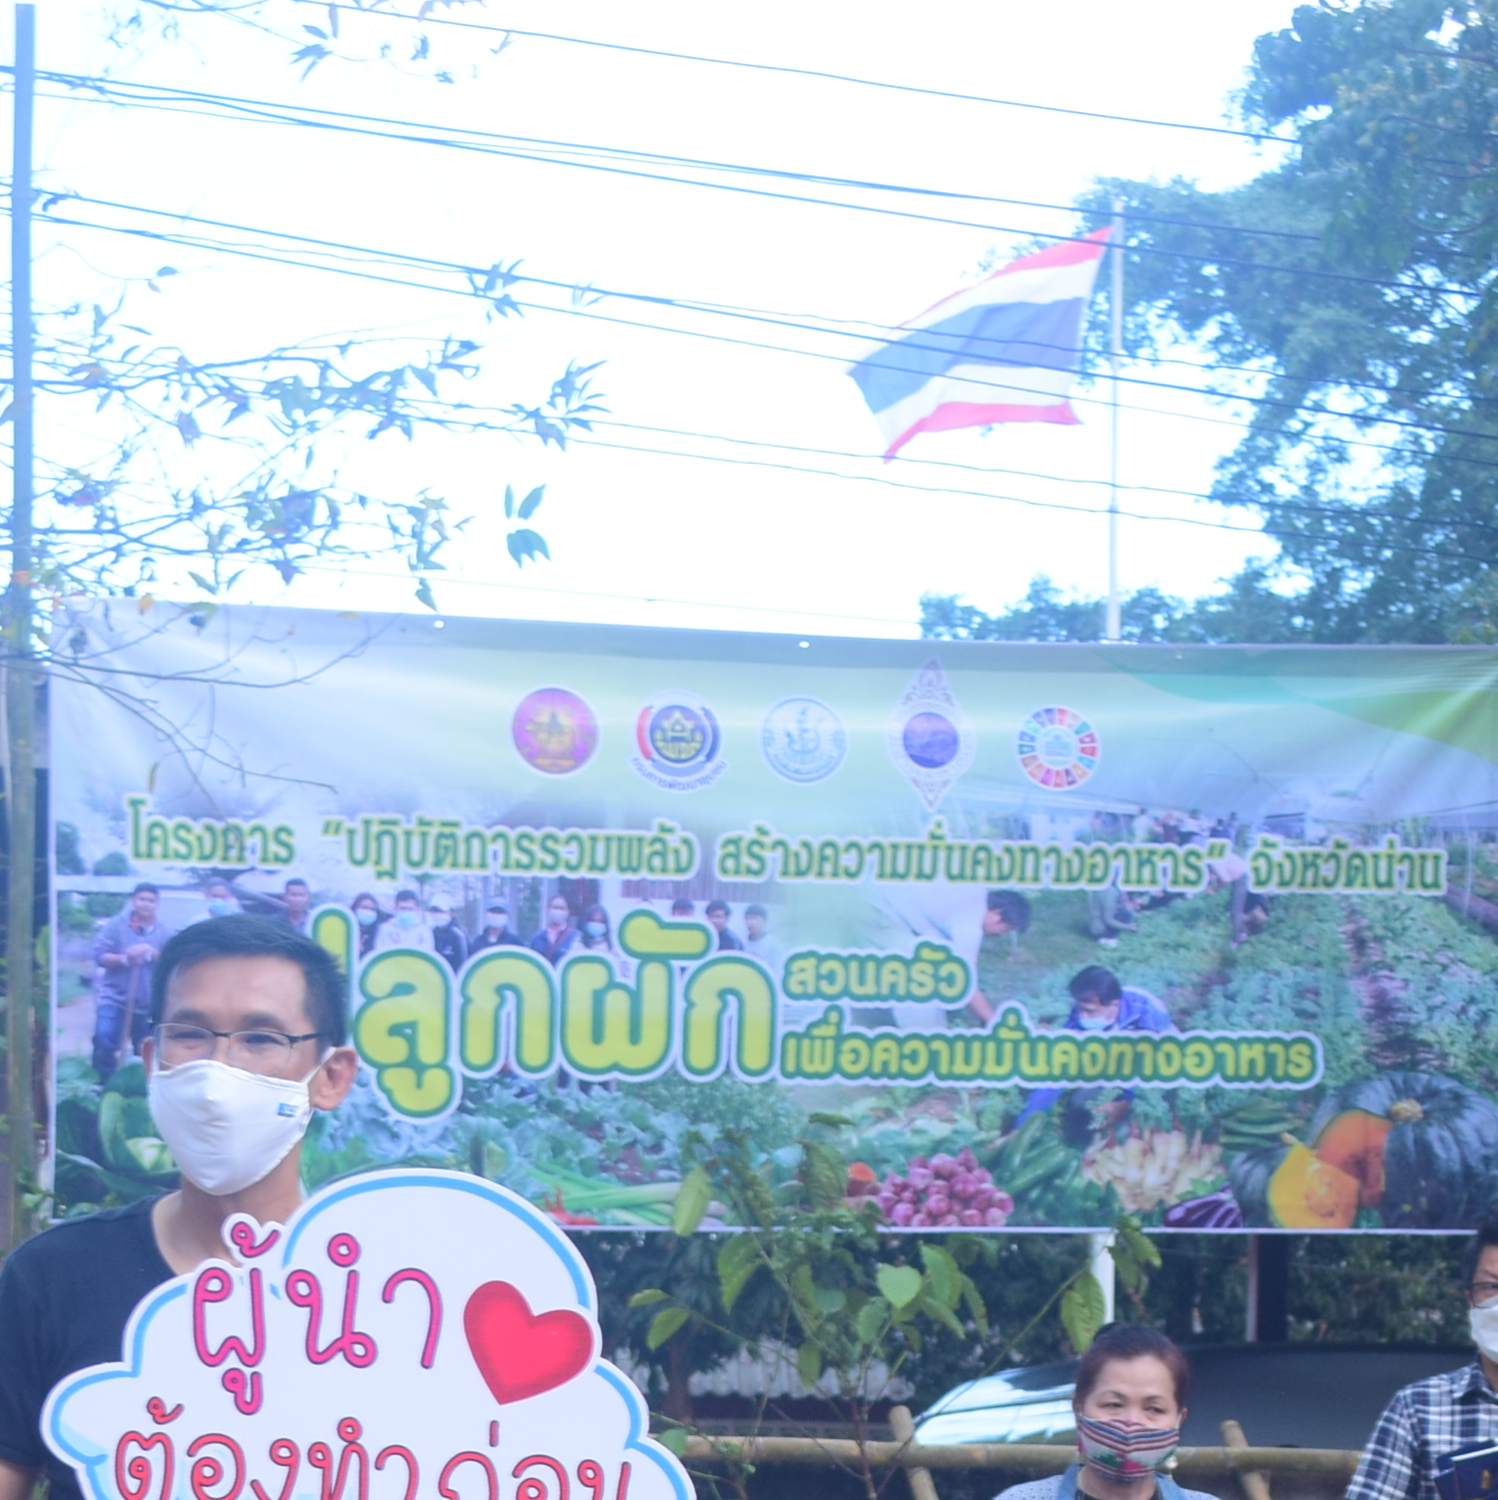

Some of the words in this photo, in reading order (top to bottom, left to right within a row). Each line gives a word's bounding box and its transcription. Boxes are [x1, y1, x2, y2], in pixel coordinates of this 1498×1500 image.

[127, 797, 295, 867] โครงการ
[1250, 833, 1445, 892] จังหวัดน่าน
[313, 908, 778, 1117] ลูกผัก
[786, 944, 969, 998] สวนครัว
[782, 1008, 1316, 1079] เพื่อความมั่นคงทางอาหาร
[192, 1221, 444, 1415] ผู้นำ
